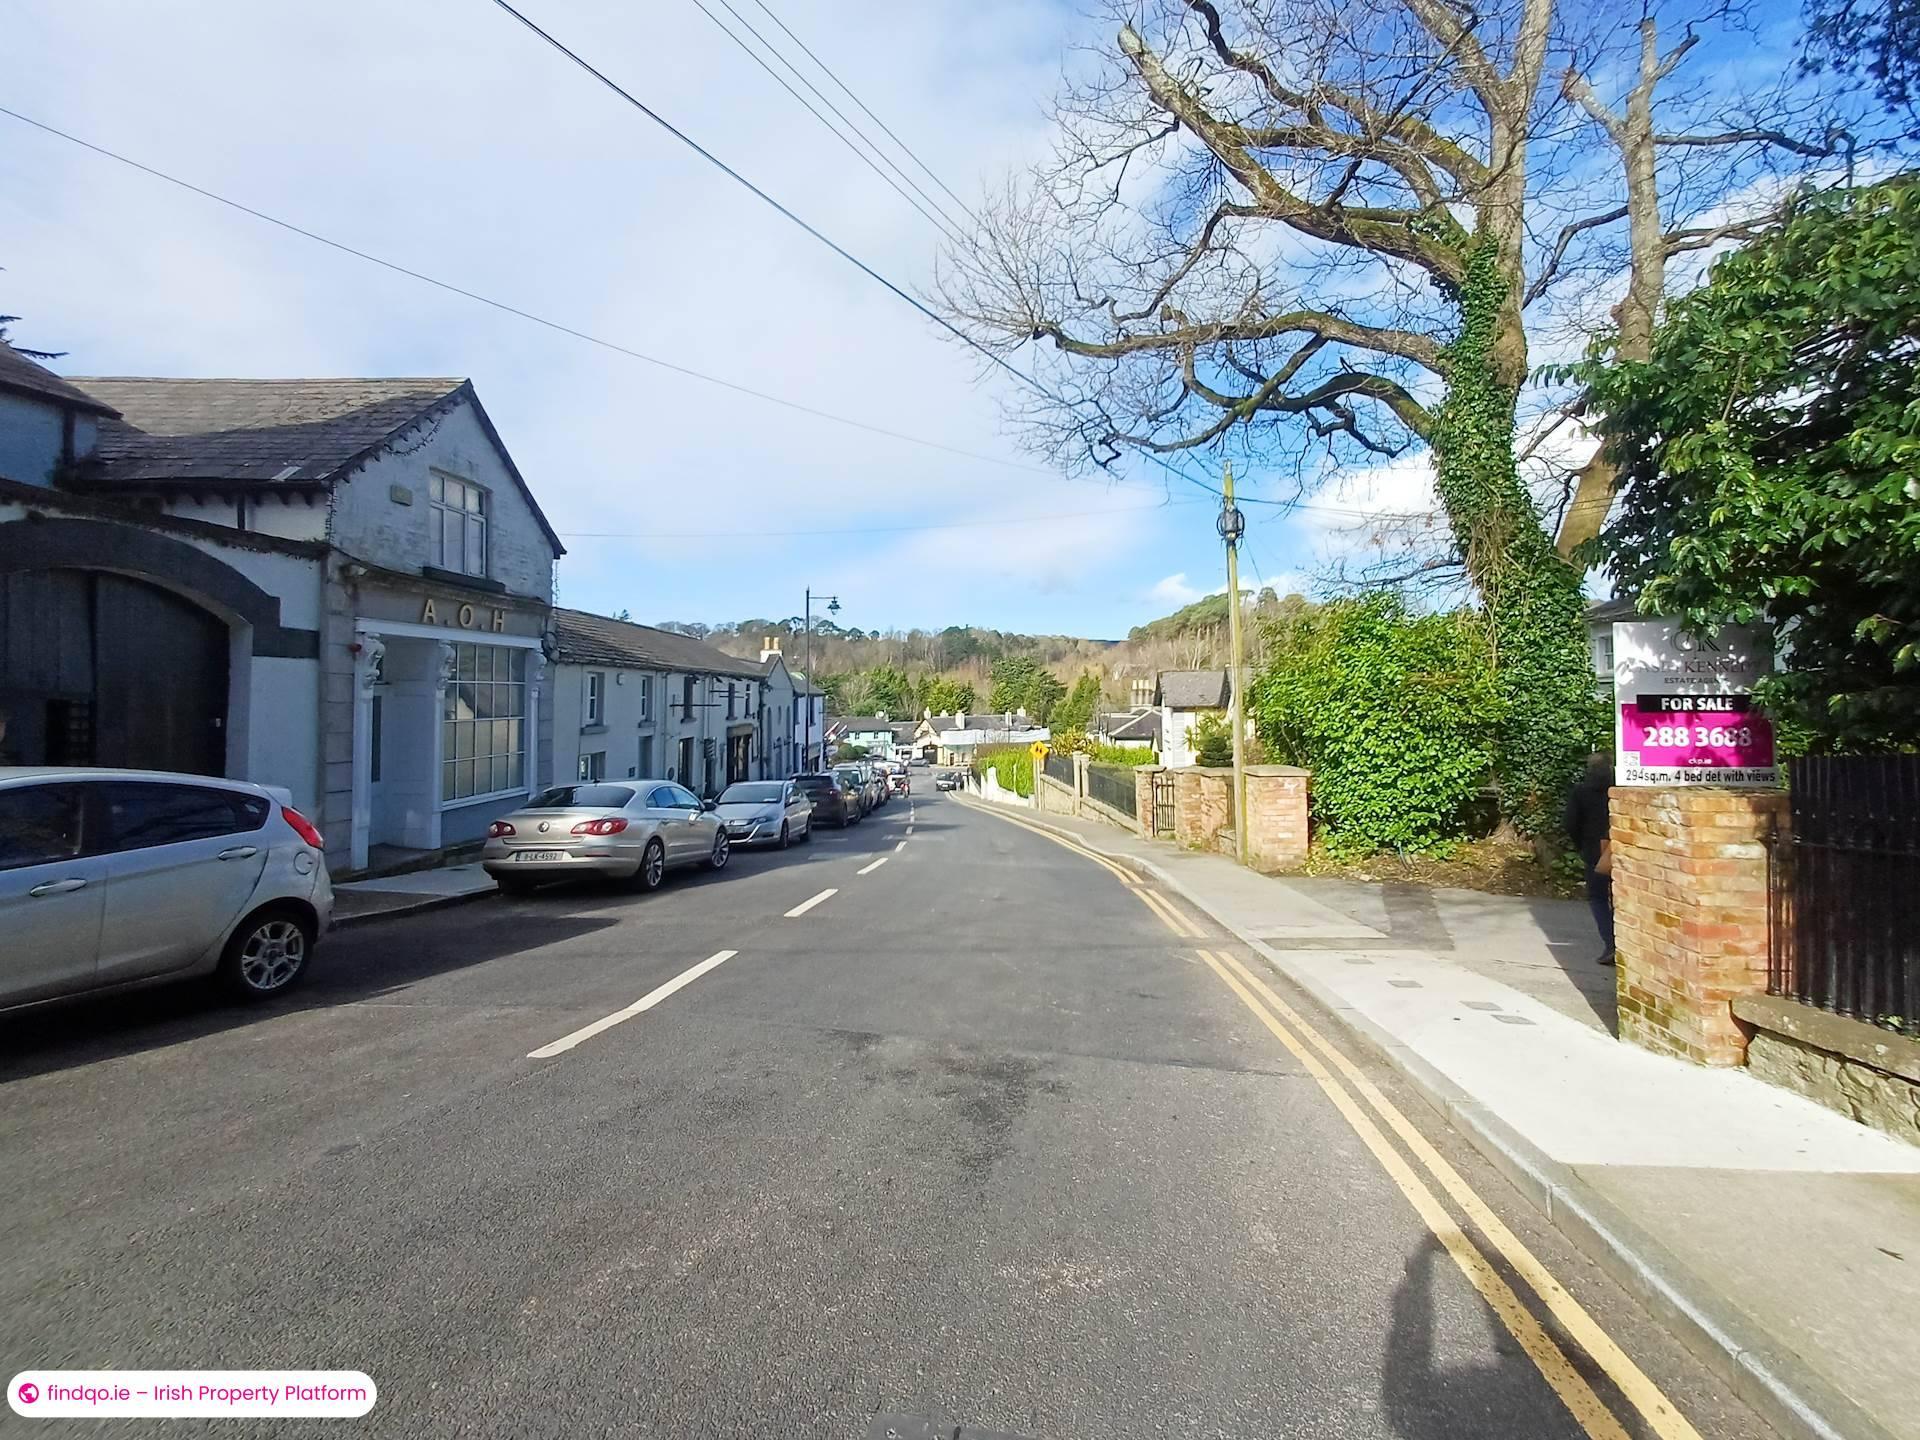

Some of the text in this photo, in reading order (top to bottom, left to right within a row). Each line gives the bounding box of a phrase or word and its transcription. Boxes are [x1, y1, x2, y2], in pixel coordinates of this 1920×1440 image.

[1661, 697, 1733, 711] FOR SALE
[1642, 726, 1752, 747] 288 3688
[1674, 770, 1681, 780] 4
[1684, 770, 1702, 782] bed
[1705, 770, 1721, 782] det
[1723, 769, 1744, 782] with
[1746, 769, 1776, 782] views
